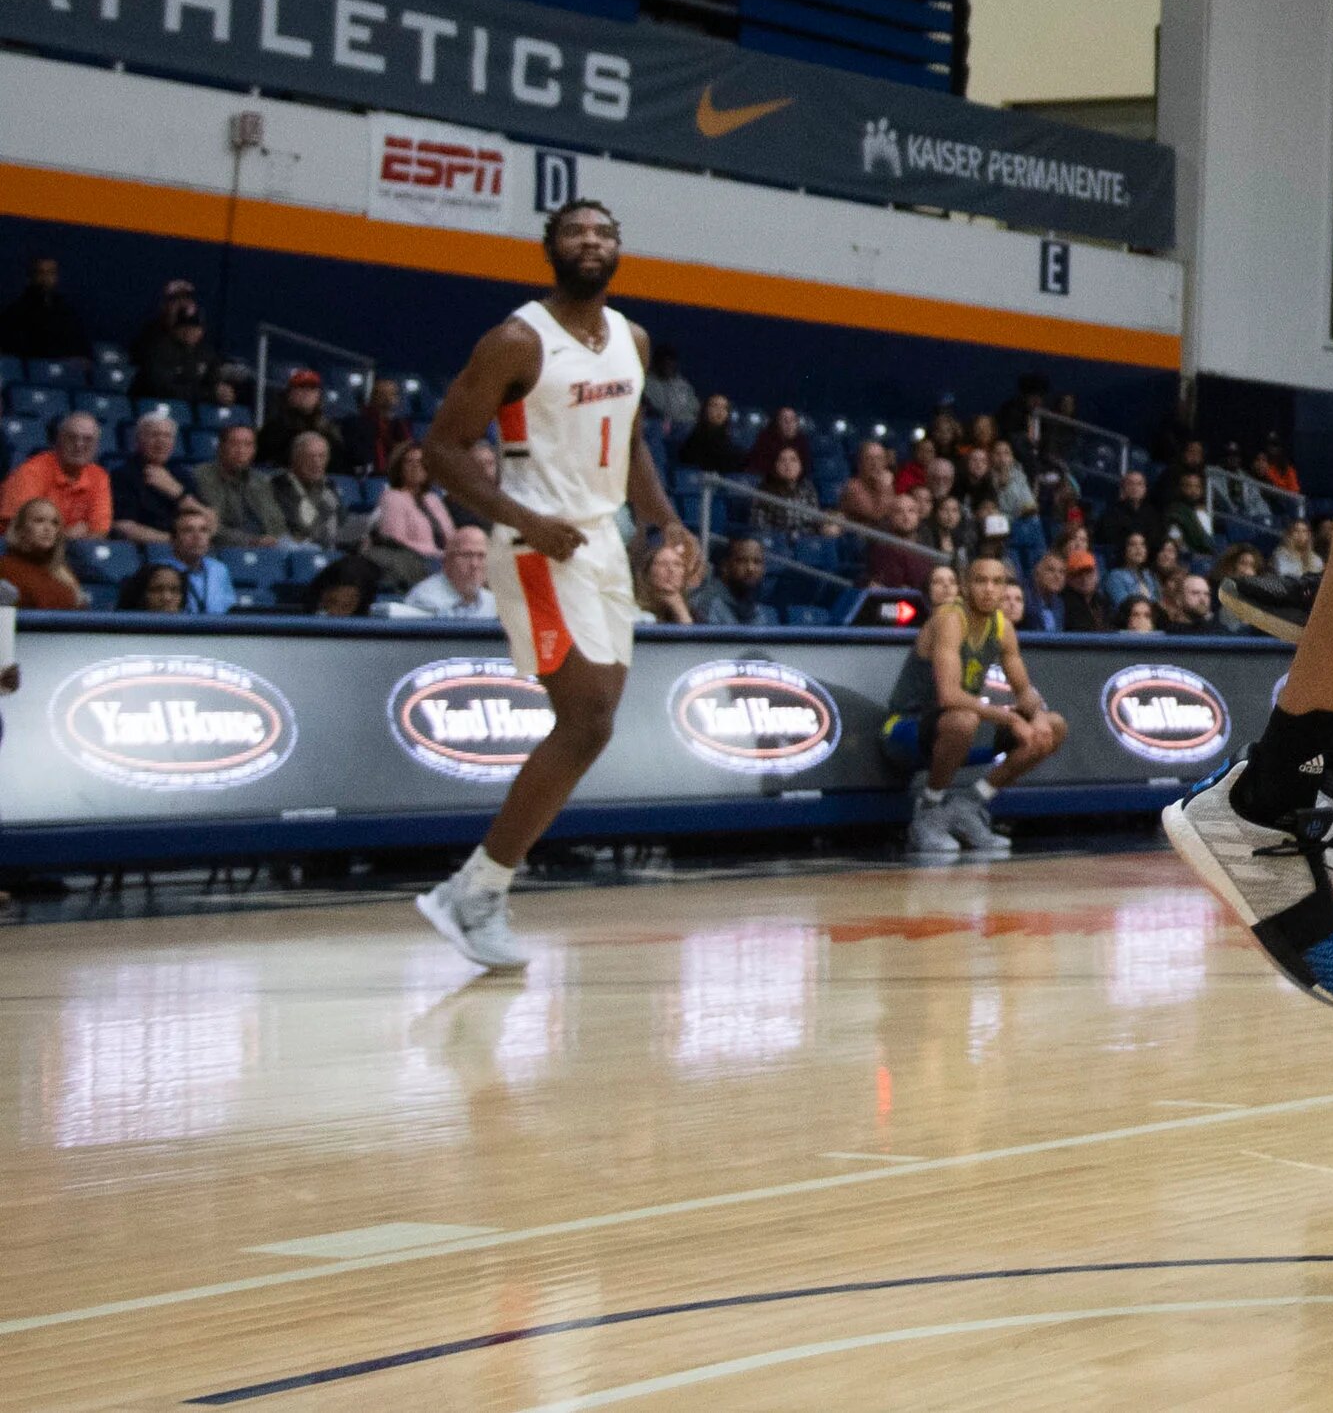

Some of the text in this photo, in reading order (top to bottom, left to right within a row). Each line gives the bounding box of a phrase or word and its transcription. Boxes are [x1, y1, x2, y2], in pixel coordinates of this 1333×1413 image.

[381, 134, 504, 195] ESPN
[907, 134, 982, 181] KAISER
[545, 155, 569, 211] D
[1046, 243, 1064, 293] E
[600, 417, 611, 468] 1
[88, 700, 265, 745] Yard House
[484, 699, 557, 741] Hous
[695, 698, 820, 736] Yard House
